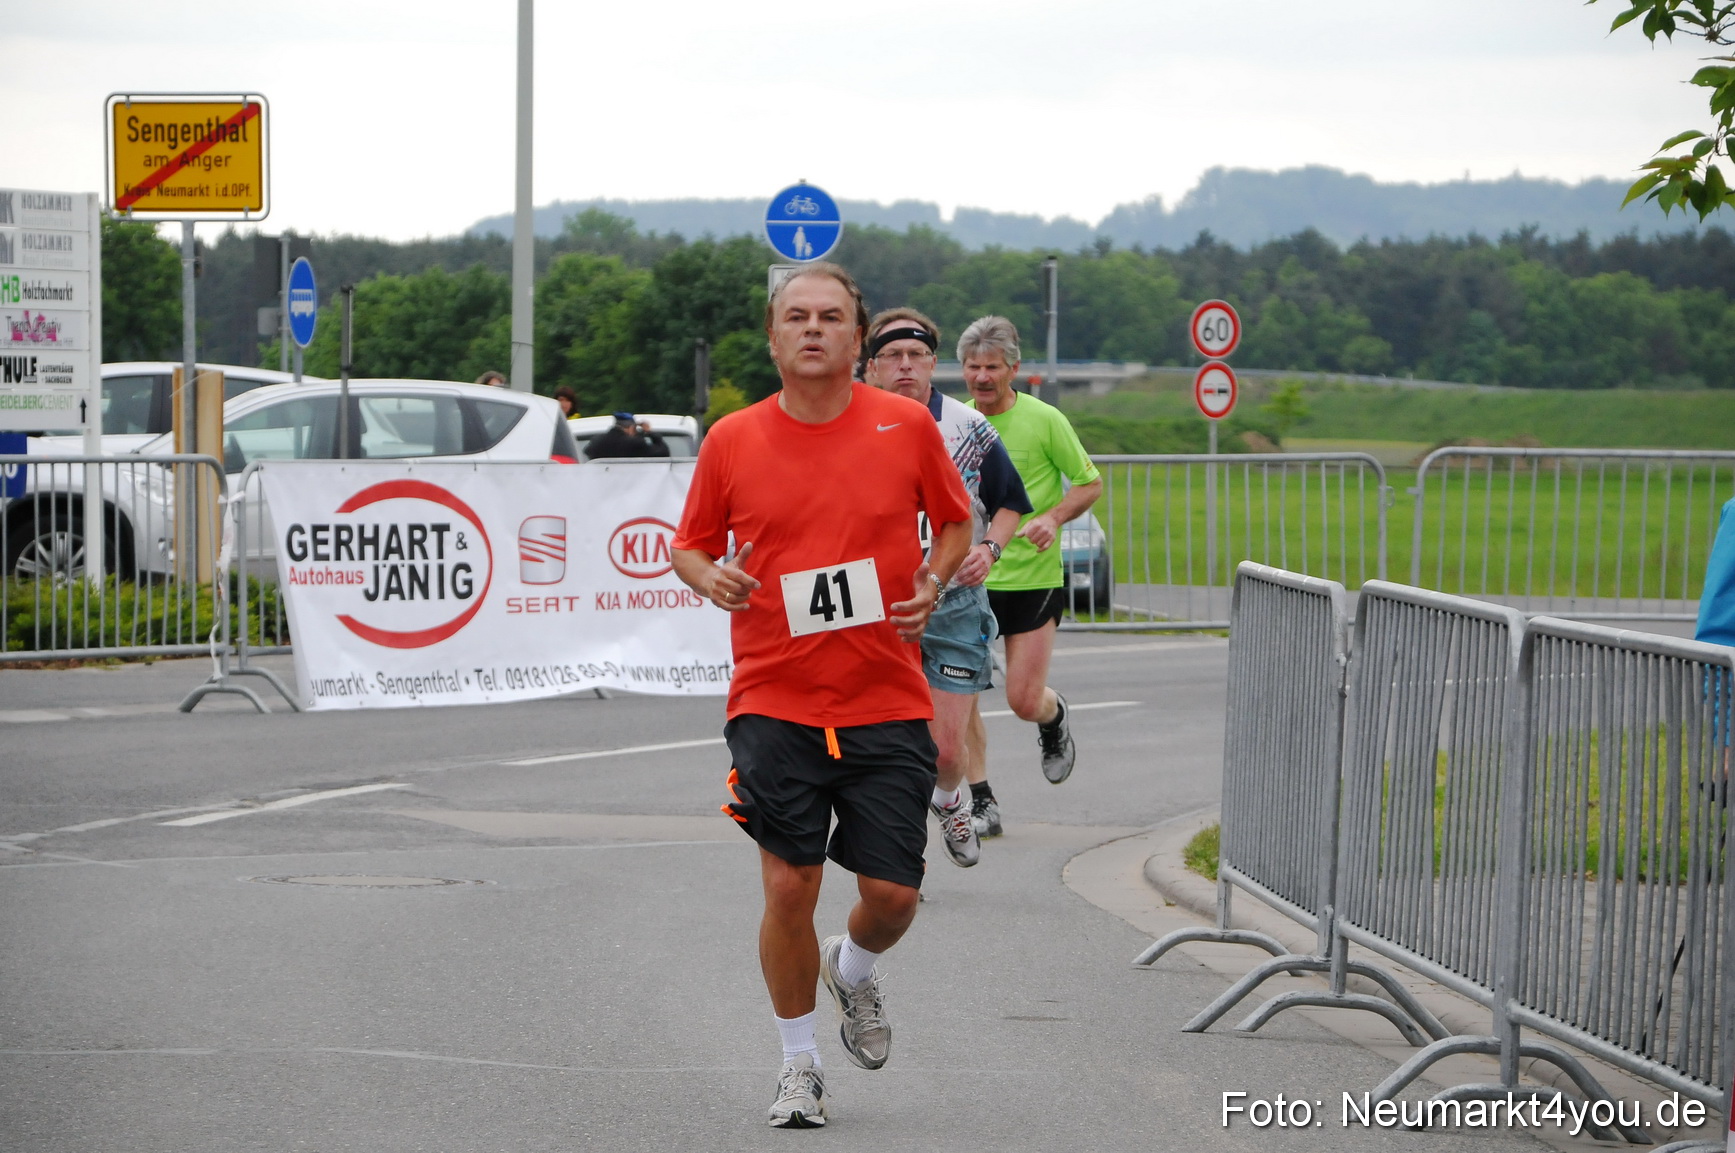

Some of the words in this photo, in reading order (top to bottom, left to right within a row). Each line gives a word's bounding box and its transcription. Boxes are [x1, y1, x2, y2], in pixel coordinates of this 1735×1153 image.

[127, 115, 248, 150] Sengenthal
[143, 154, 169, 168] am
[178, 151, 232, 172] Anger
[124, 183, 151, 197] Kreis
[156, 183, 210, 198] Neumarkt
[21, 193, 73, 212] HOLZAMMER
[21, 233, 73, 252] HOLZAMMER
[22, 280, 73, 301] Holzfachmarkt
[1203, 317, 1229, 342] 60
[286, 523, 450, 562] GERHART
[455, 531, 468, 551] &
[622, 532, 671, 564] KIA
[288, 566, 365, 585] Autohaus
[363, 561, 474, 602] JÄNIG
[506, 596, 580, 614] SEAT
[595, 591, 621, 611] KIA
[627, 589, 704, 610] MOTORS
[809, 569, 854, 622] 41
[375, 669, 462, 700] Sengenthal
[474, 668, 503, 692] Tel.
[505, 664, 580, 690] 09181/26
[627, 659, 735, 688] www.gerhart
